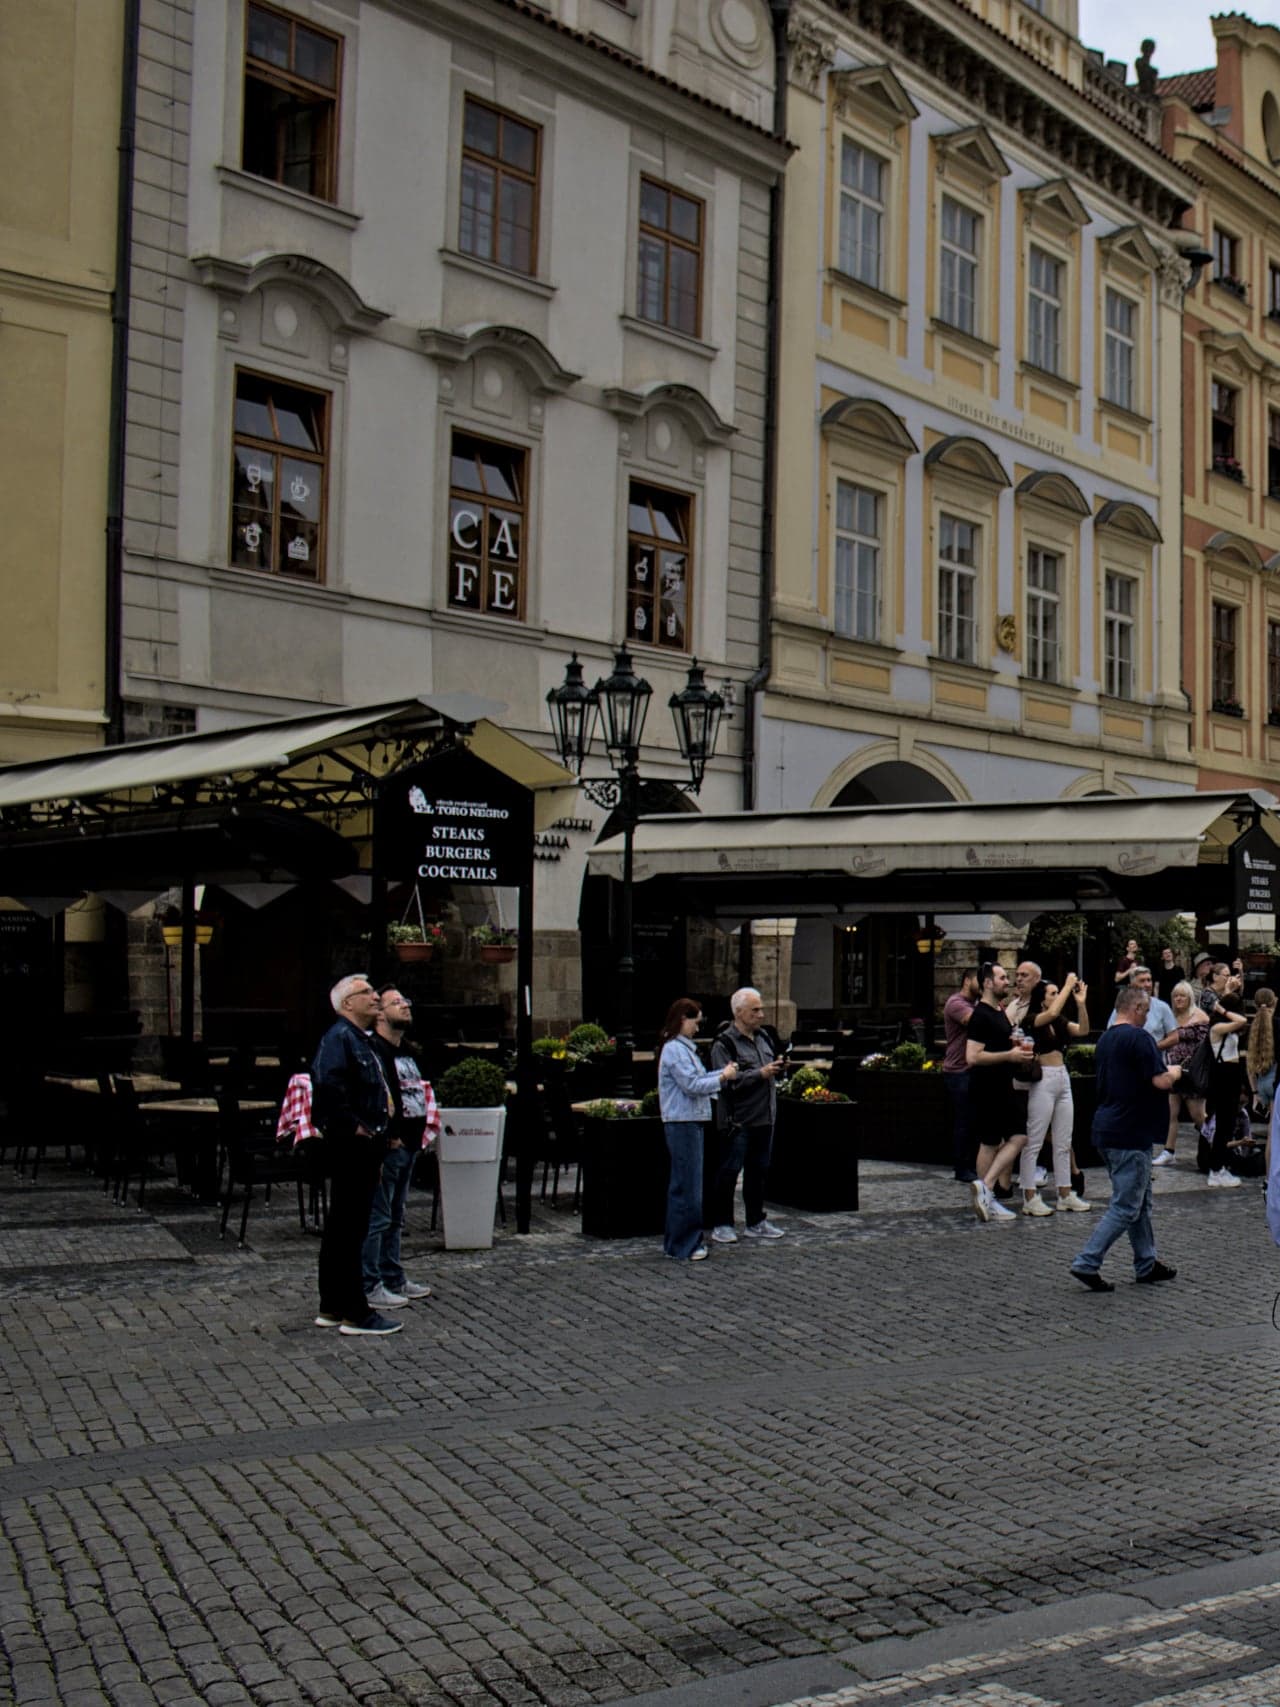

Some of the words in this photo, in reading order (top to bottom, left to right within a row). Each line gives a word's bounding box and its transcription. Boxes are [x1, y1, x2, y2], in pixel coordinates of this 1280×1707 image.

[435, 806, 468, 817] TORO
[469, 808, 510, 820] NEGRO
[432, 826, 486, 841] STEAKS
[425, 845, 491, 861] BURGERS
[418, 864, 498, 880] COCKTAILS
